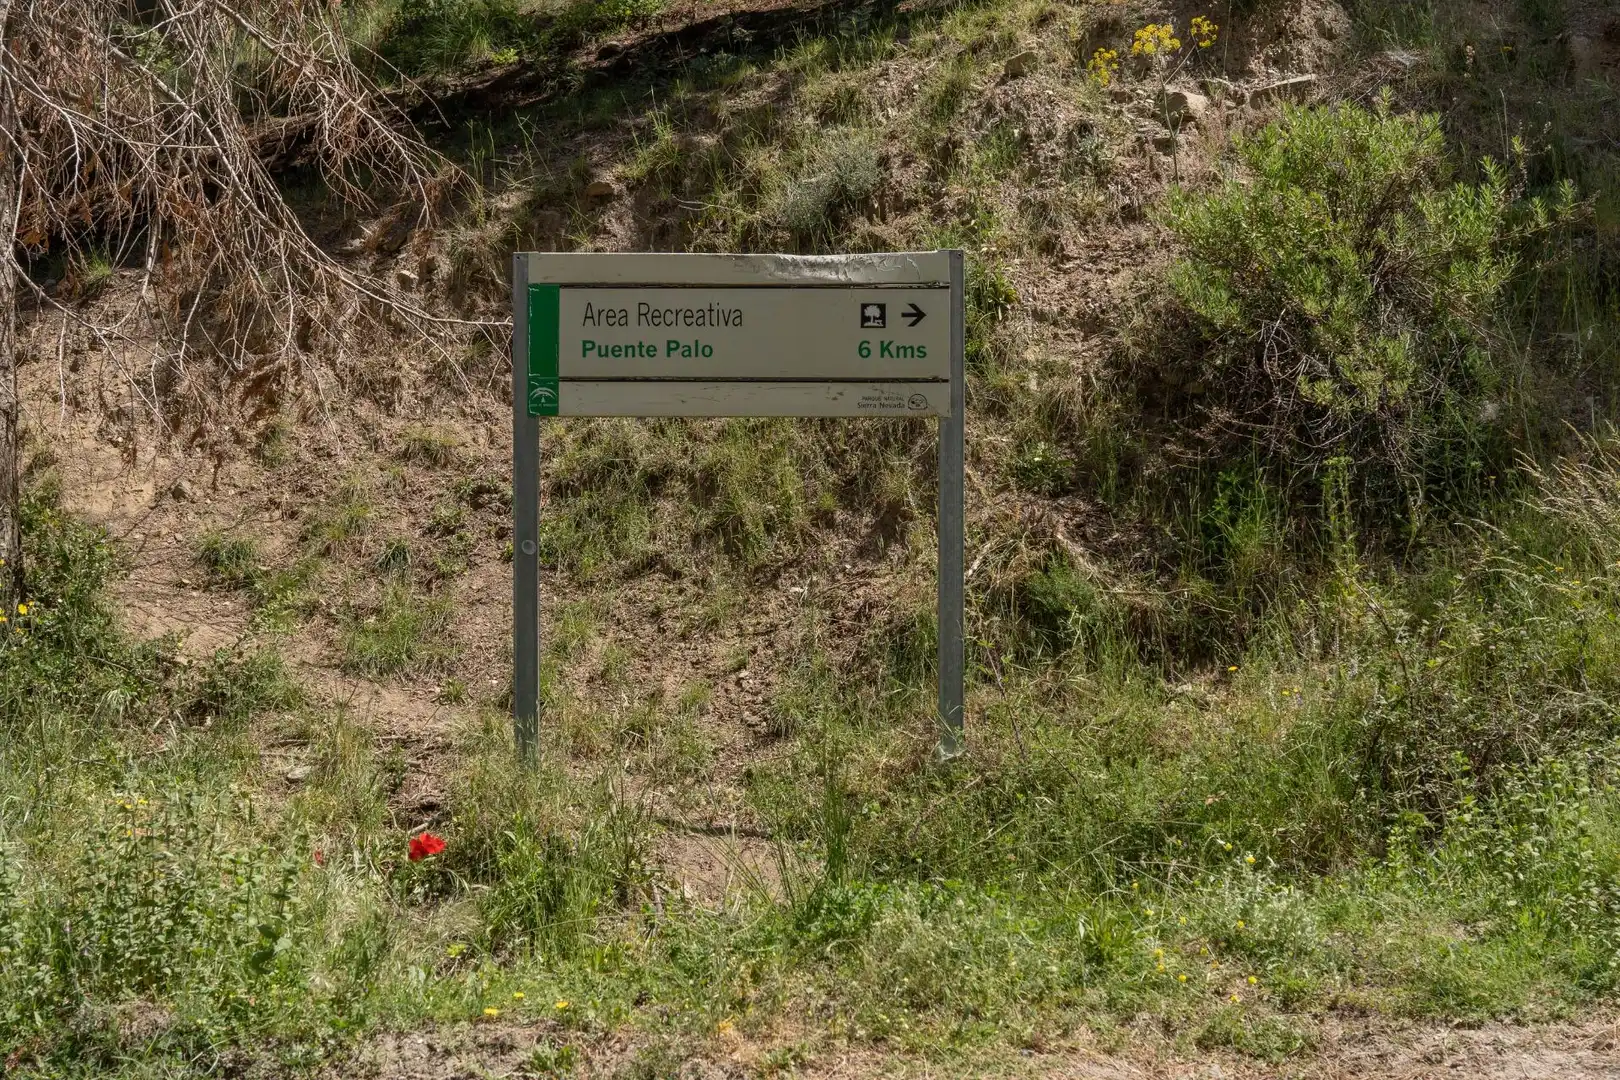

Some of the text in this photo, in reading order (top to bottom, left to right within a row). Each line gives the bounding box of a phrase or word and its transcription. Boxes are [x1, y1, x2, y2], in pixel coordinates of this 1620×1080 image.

[582, 302, 743, 327] Area Recreativa
[582, 340, 713, 358] Puente Palo
[858, 340, 928, 359] 6 Kms
